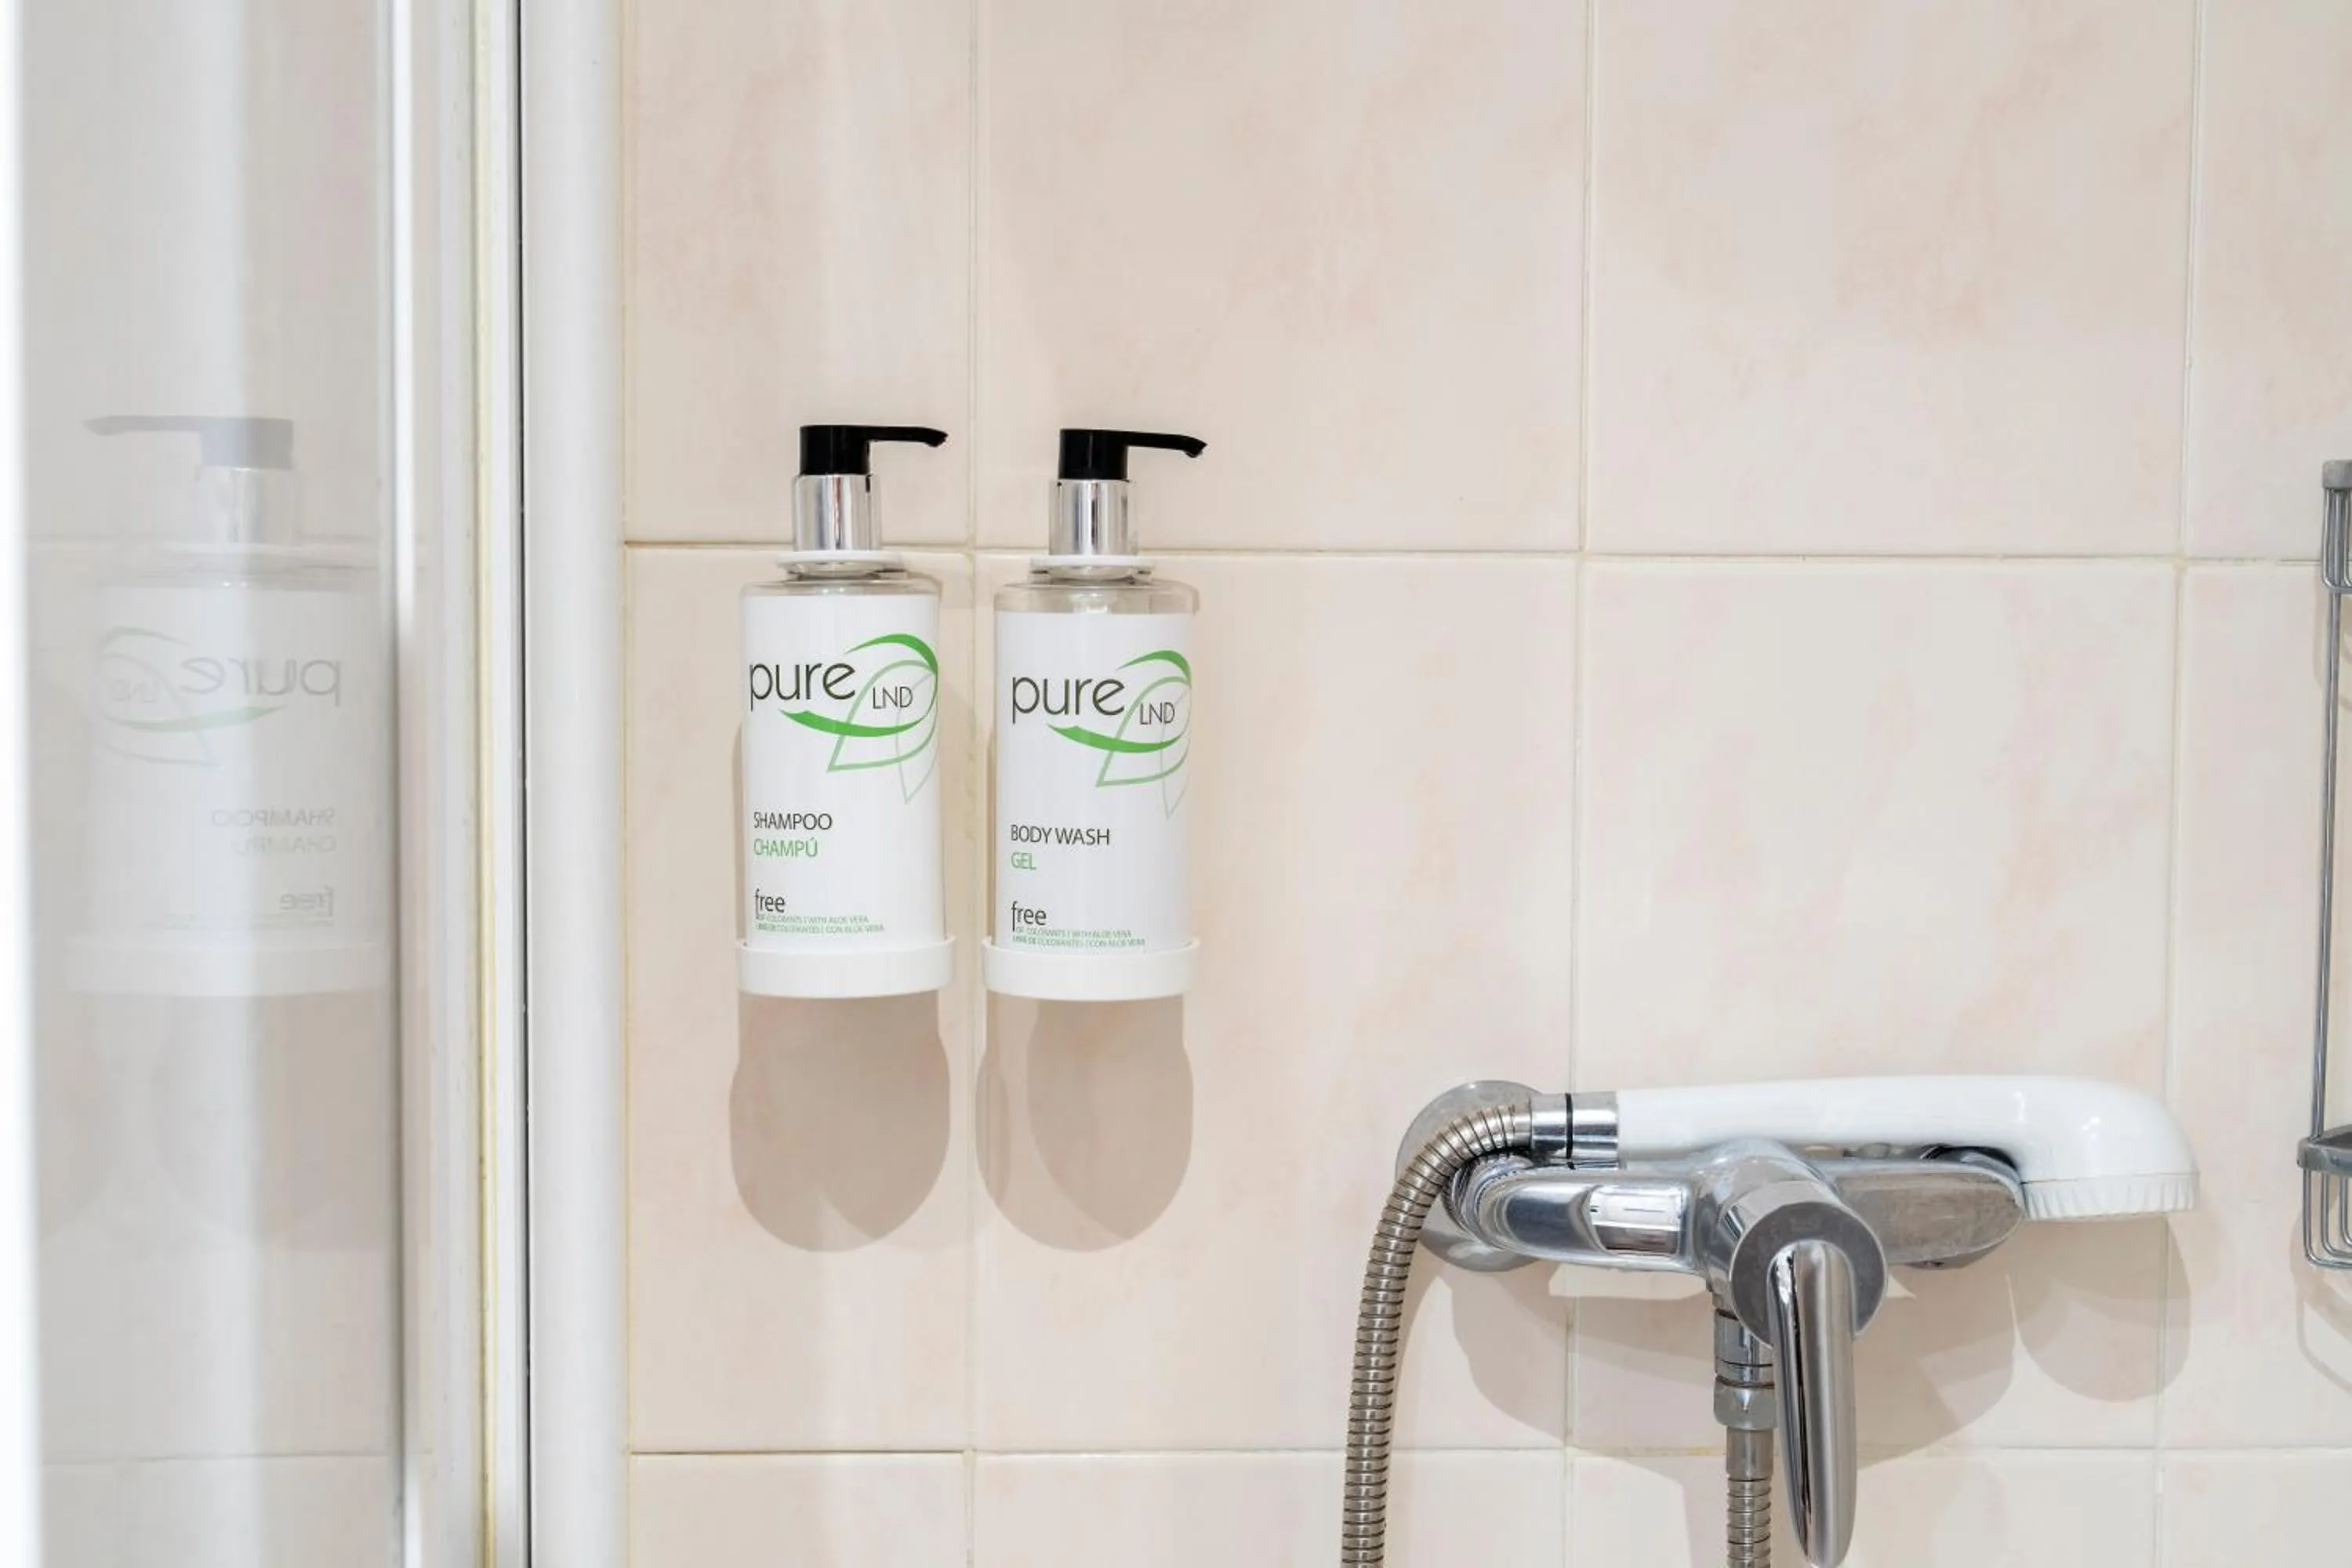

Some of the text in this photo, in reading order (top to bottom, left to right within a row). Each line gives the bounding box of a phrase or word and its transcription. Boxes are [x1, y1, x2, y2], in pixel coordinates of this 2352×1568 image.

[749, 662, 913, 712] pure LND
[1012, 677, 1175, 725] pure LND
[753, 811, 833, 830] SHAMPOO
[753, 837, 818, 858] CHAMPÚ
[1011, 824, 1110, 846] BODY WASH
[1011, 851, 1037, 870] GEL
[755, 888, 786, 920] free
[1011, 901, 1047, 932] free
